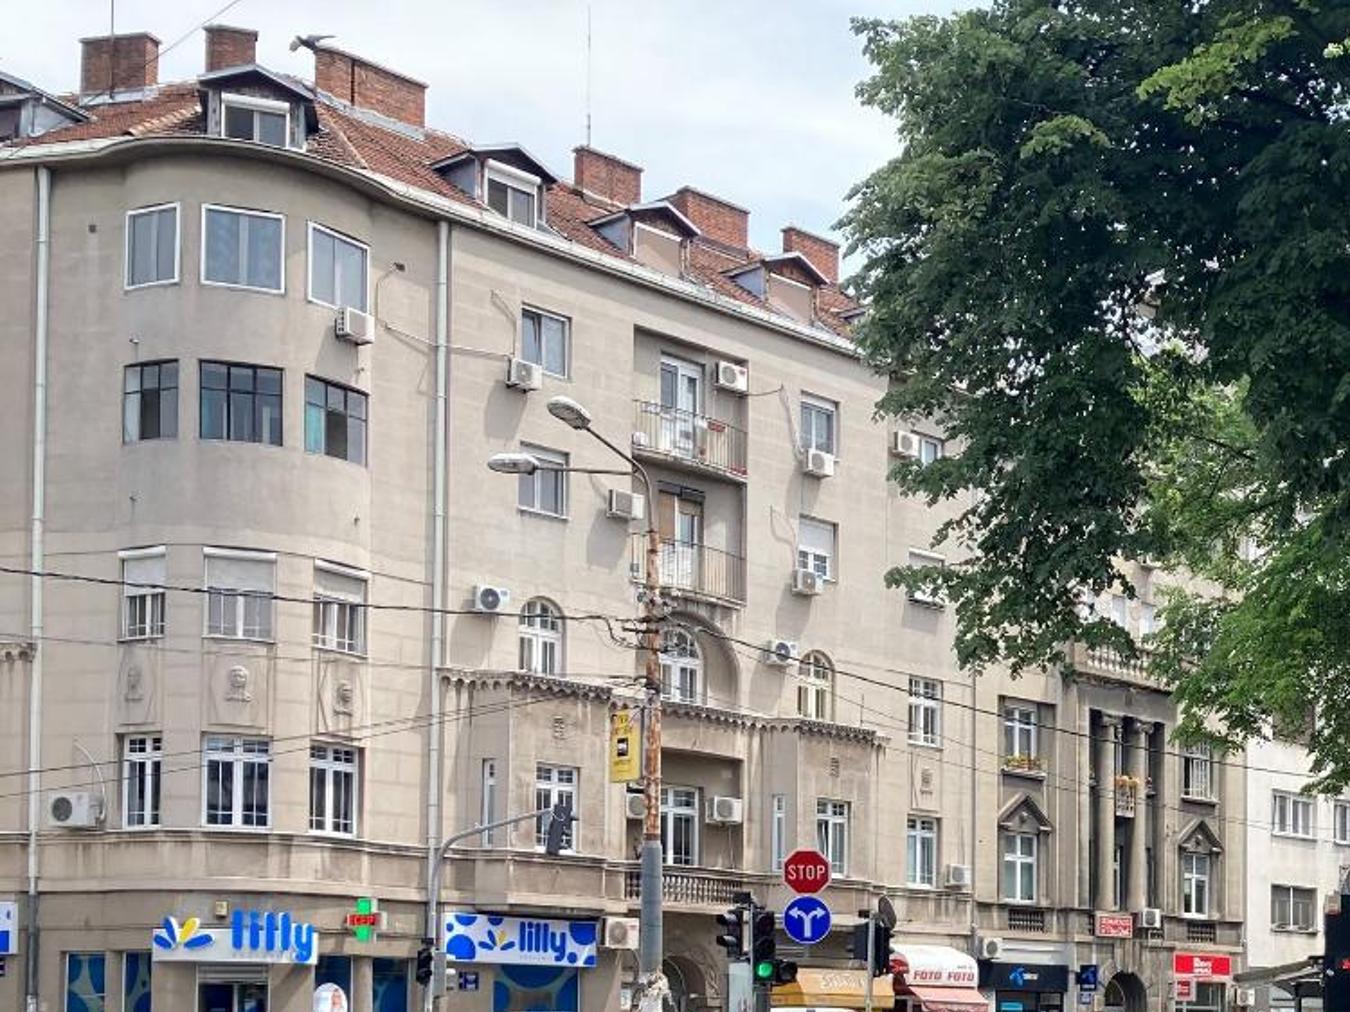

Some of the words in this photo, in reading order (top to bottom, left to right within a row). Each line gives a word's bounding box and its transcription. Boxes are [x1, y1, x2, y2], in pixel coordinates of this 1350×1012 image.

[788, 865, 825, 880] STOP
[231, 908, 314, 962] lilly
[519, 921, 567, 962] lilly
[913, 970, 942, 980] FOTO
[947, 971, 975, 982] FOTO
